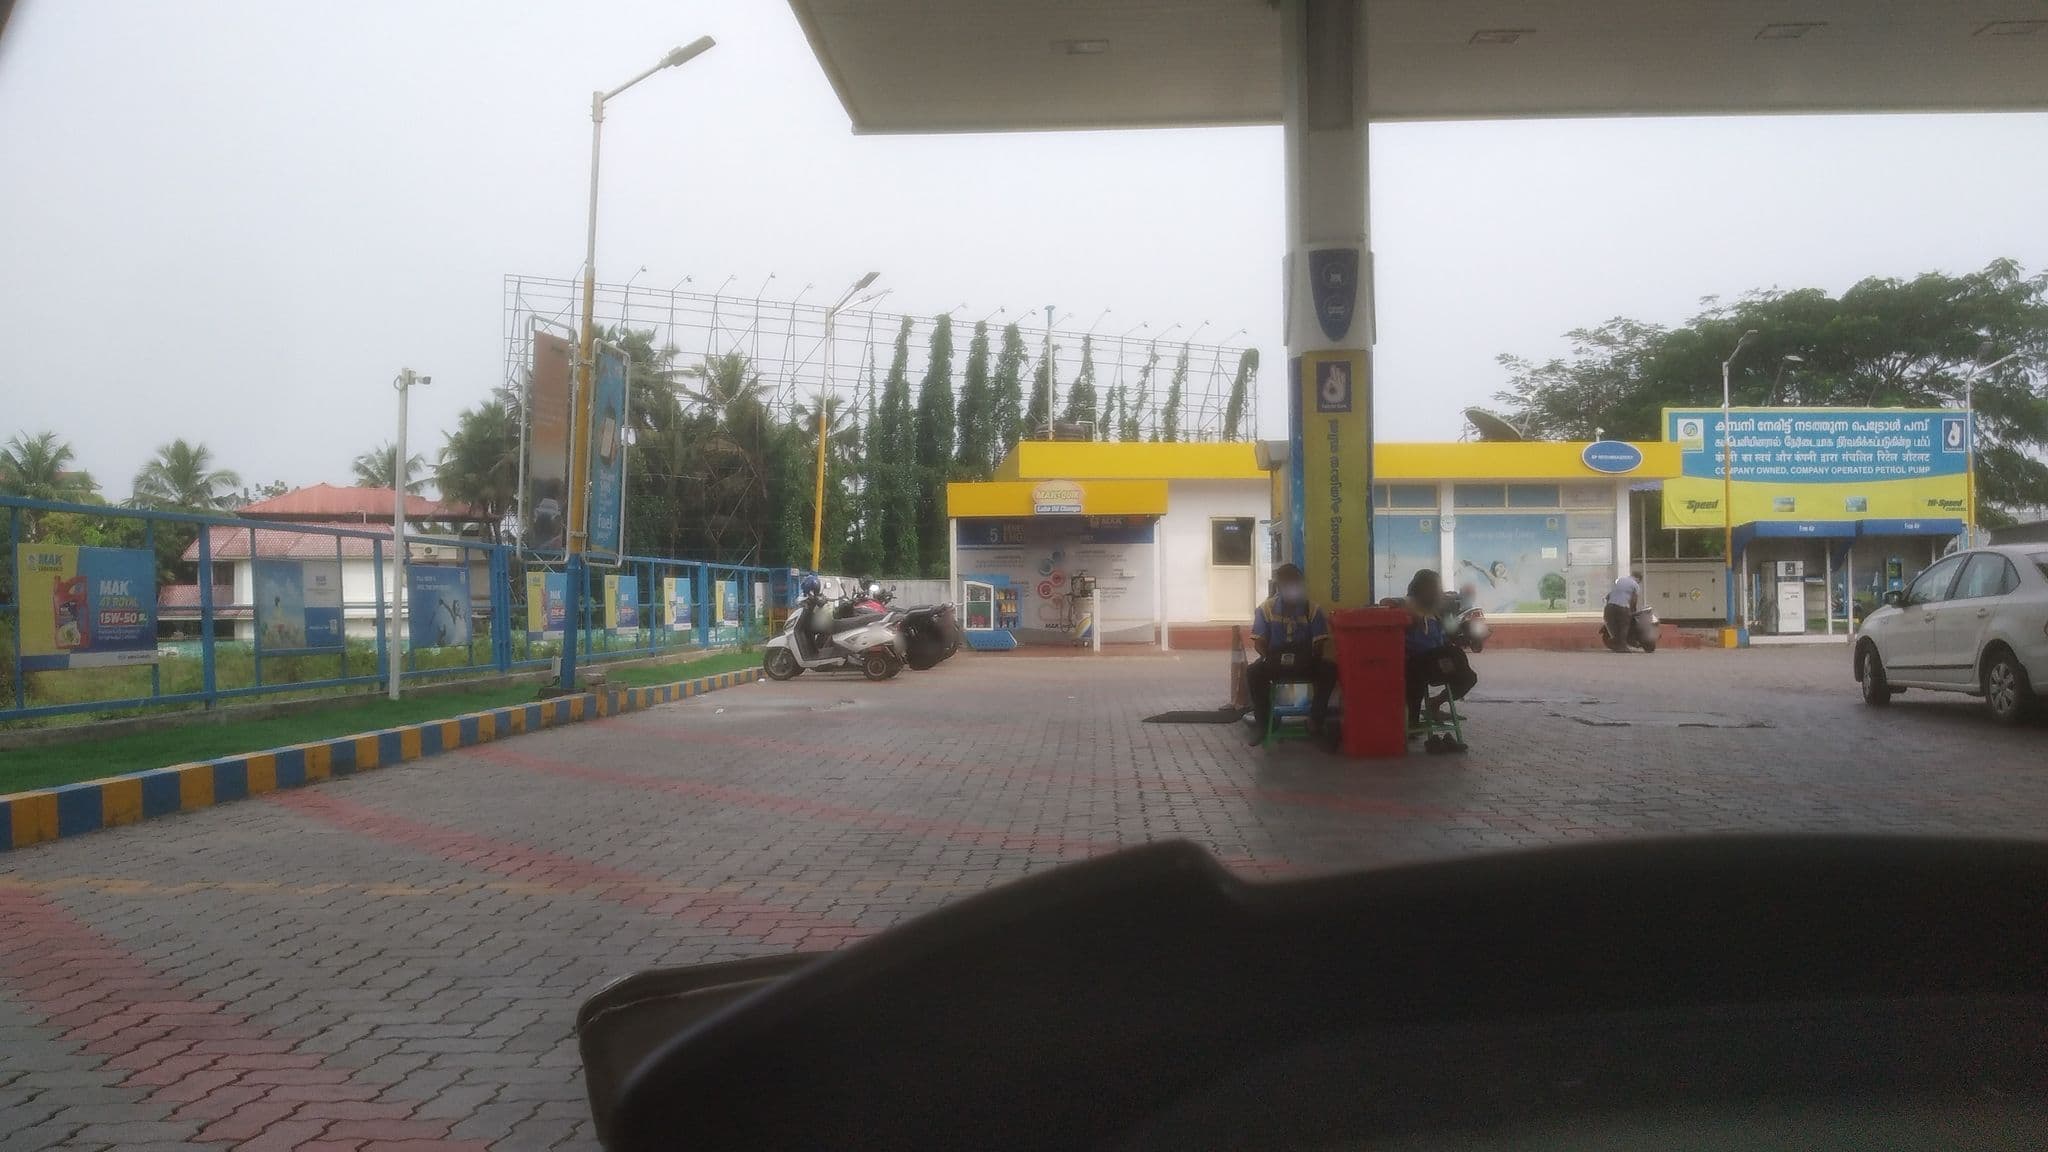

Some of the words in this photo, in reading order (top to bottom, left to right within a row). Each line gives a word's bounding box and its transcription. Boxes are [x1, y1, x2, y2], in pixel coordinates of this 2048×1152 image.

[1795, 420, 1848, 434] നടത്തുന്ന
[1741, 452, 1752, 462] का
[1775, 450, 1792, 462] और
[1794, 450, 1817, 462] कंपनी
[1820, 452, 1838, 462] द्वारा
[1876, 450, 1898, 462] रिटेल
[1790, 466, 1829, 474] COMPANY
[1831, 466, 1874, 474] OPERATED
[1875, 465, 1906, 474] PETROL
[1908, 465, 1931, 473] PUMP
[1686, 499, 1719, 513] Speed
[1927, 498, 1963, 509] Hi-Speed
[99, 580, 129, 596] MAK
[100, 612, 137, 624] 15W-50
